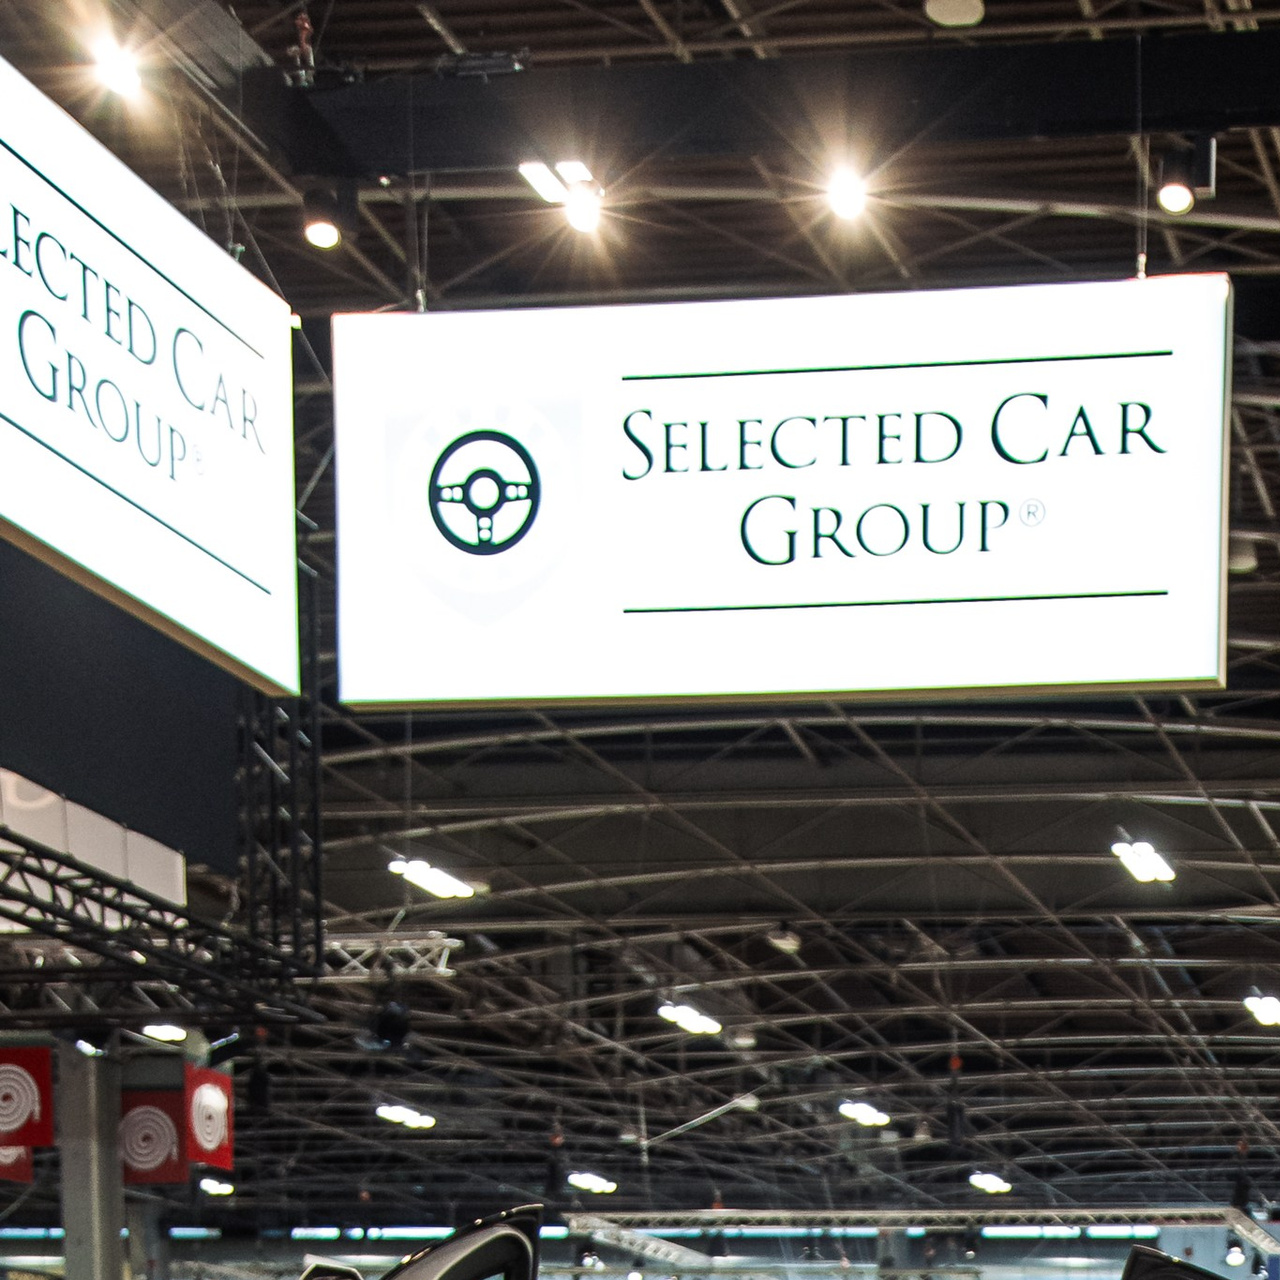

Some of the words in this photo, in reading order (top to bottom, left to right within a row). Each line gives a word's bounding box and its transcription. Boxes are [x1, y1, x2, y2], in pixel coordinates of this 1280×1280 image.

[0, 203, 157, 366] ECTED
[173, 327, 266, 455] CAR
[622, 408, 964, 480] SELECTED
[990, 392, 1169, 466] CAR
